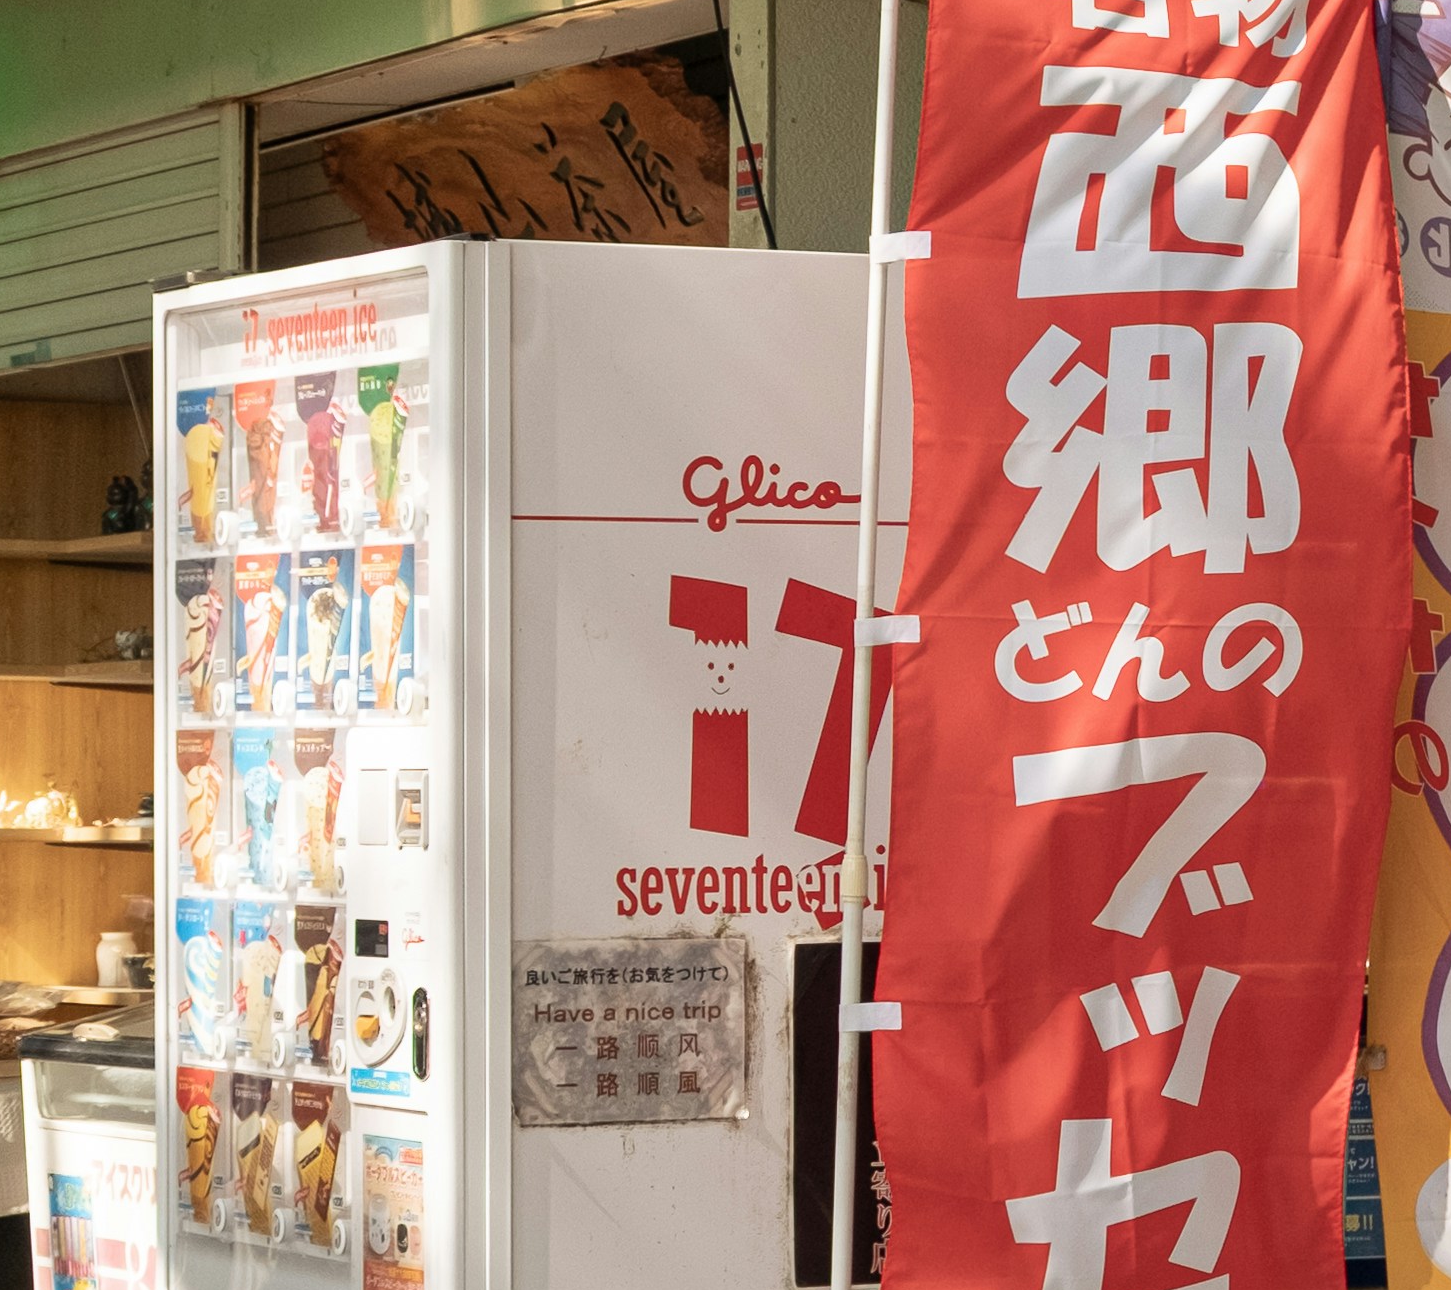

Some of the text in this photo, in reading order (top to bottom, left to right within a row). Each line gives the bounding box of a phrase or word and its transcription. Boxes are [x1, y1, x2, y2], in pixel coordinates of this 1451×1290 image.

[267, 303, 348, 357] seventeen
[352, 288, 378, 344] ice
[1002, 65, 1305, 574] 西郷
[682, 454, 862, 533] Glico
[993, 598, 1303, 703] どんの
[525, 965, 730, 987] 良いご旅行を(お気をつけて)
[534, 1000, 722, 1023] Have a nice trip
[555, 1033, 701, 1062] 一路顺风
[555, 1071, 701, 1099] 一路順風
